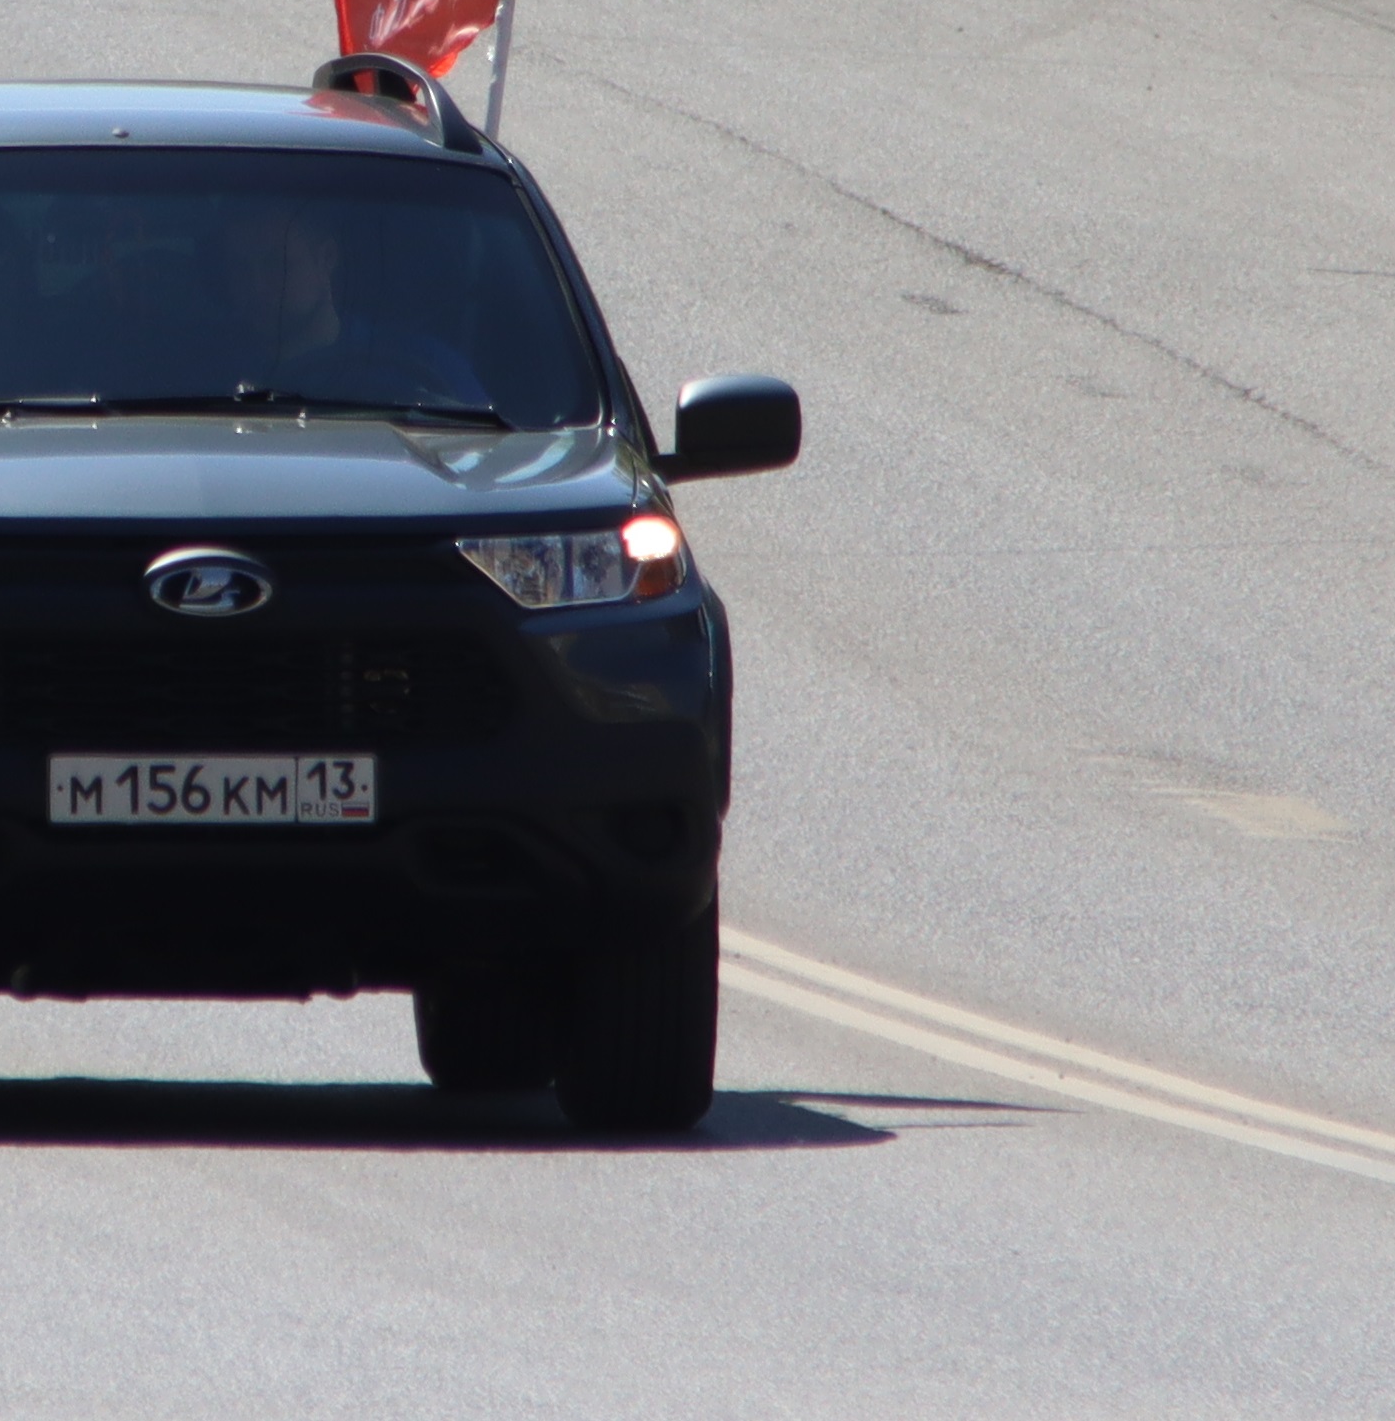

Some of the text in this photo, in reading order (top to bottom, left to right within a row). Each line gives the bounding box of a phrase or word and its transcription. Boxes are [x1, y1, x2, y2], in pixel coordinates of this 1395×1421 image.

[70, 760, 356, 816] М156КМ 13
[299, 801, 342, 818] RUS
